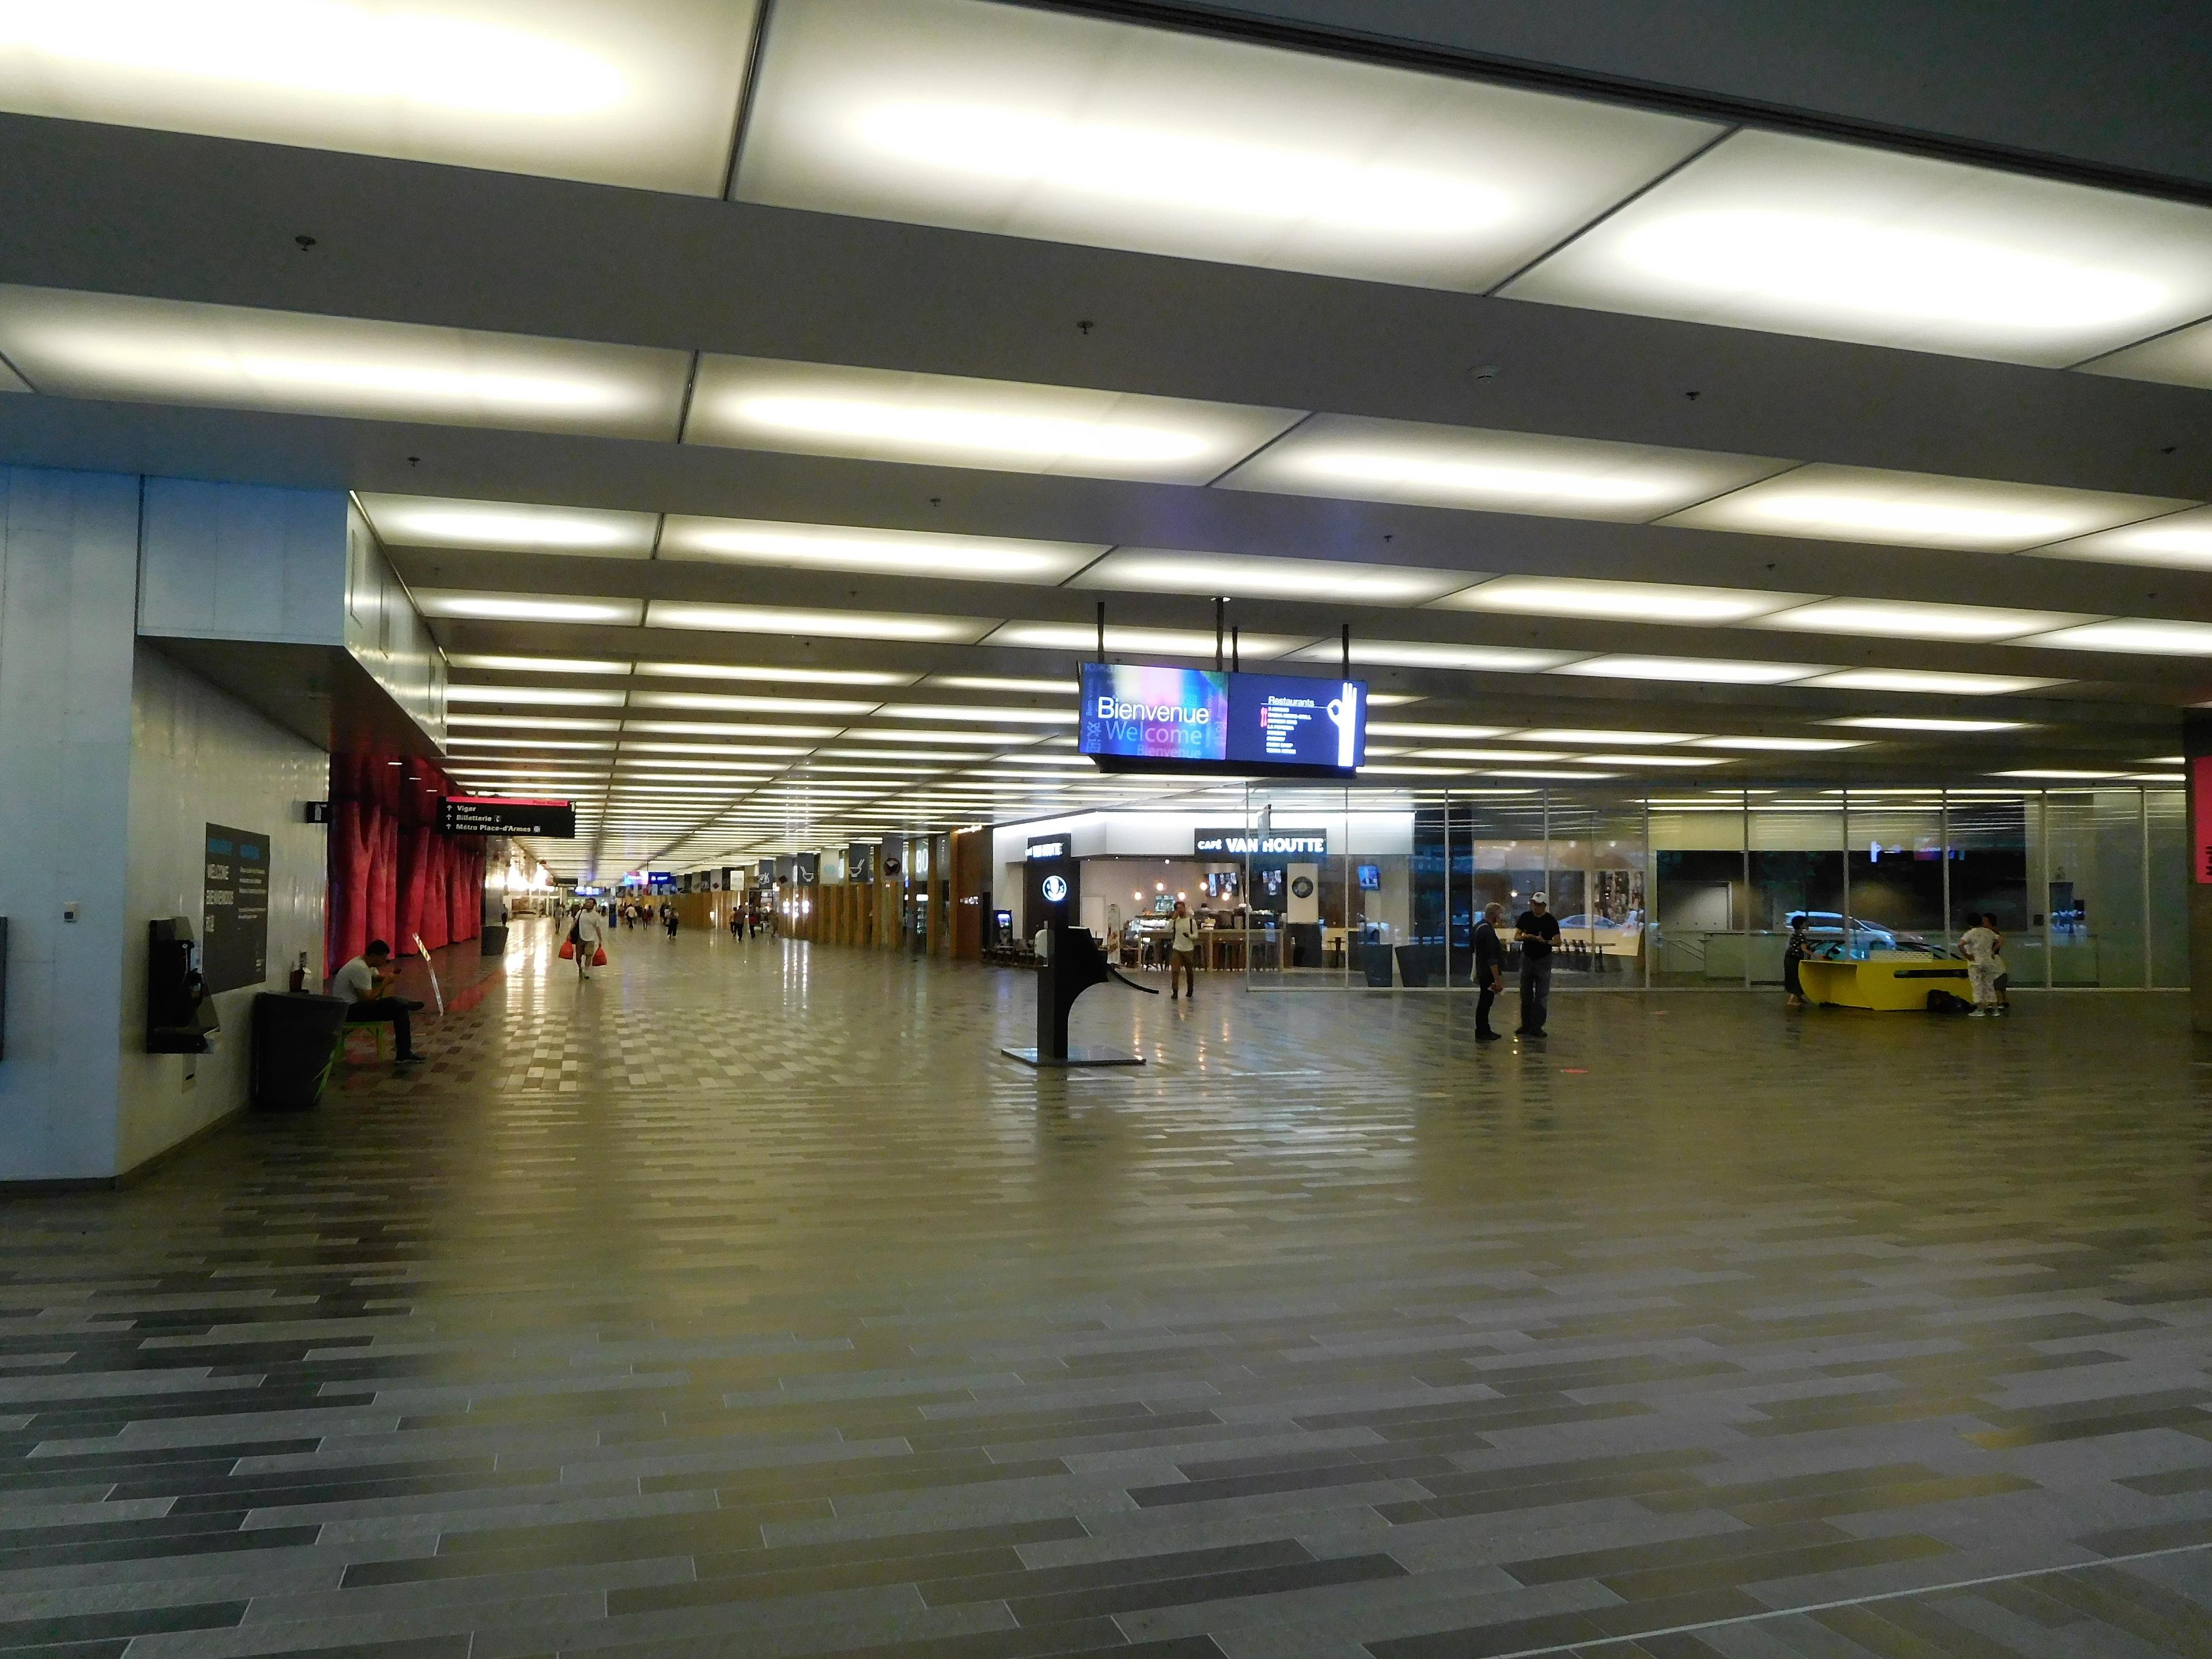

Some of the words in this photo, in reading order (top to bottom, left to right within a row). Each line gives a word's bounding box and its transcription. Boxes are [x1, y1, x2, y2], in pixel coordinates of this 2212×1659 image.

[1097, 696, 1209, 724] Bienvenue
[1268, 696, 1315, 707] Restaurants
[1105, 720, 1202, 745] Welcome
[1225, 838, 1259, 853] VAN
[1262, 838, 1324, 853] HOUTTE
